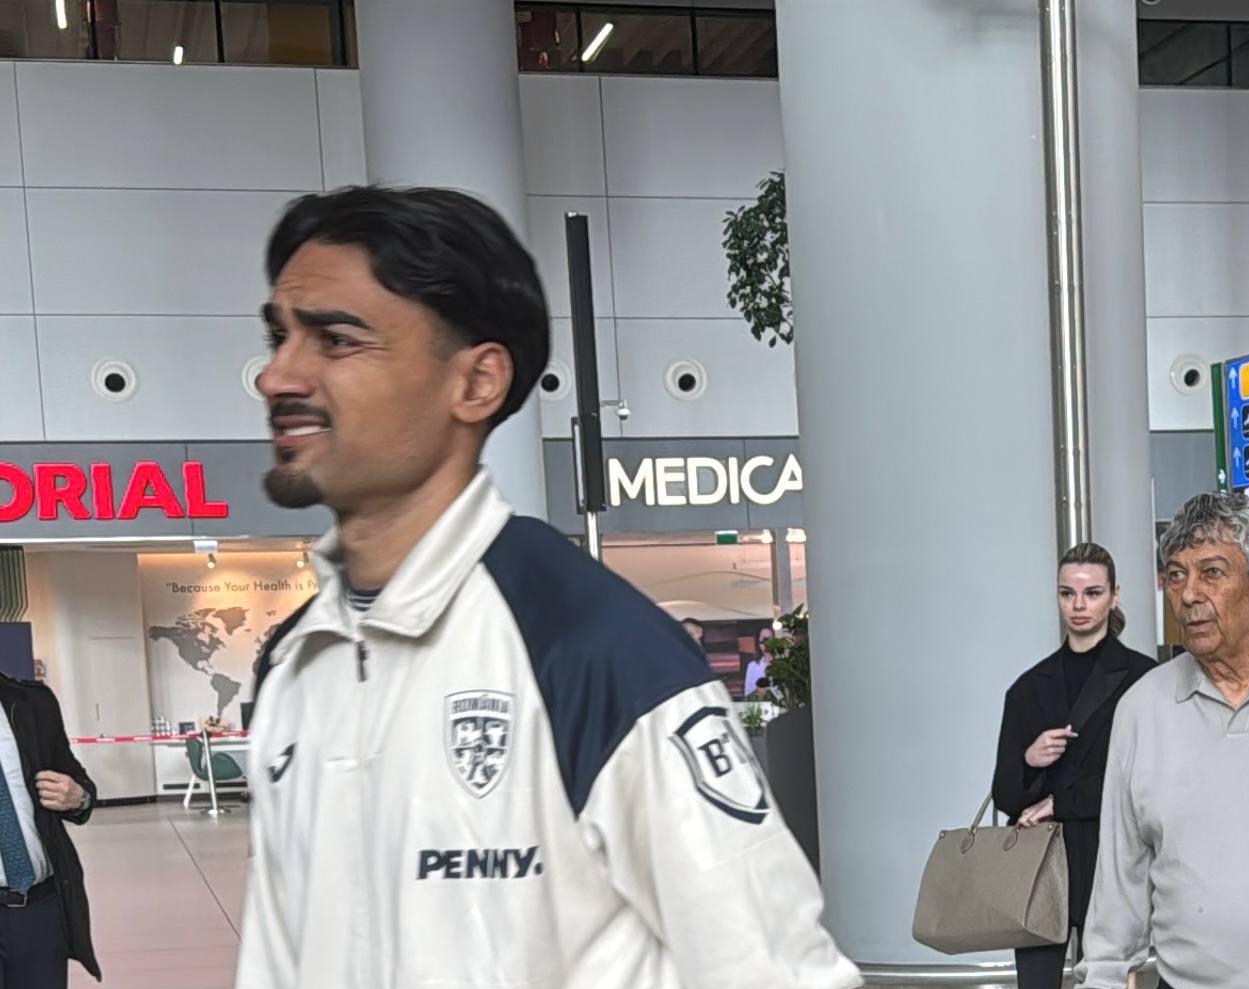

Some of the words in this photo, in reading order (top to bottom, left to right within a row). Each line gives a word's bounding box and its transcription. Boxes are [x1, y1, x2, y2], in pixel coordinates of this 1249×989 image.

[224, 581, 250, 592] Your
[253, 580, 292, 592] Health
[295, 580, 304, 590] is
[416, 845, 543, 880] PENNY.
